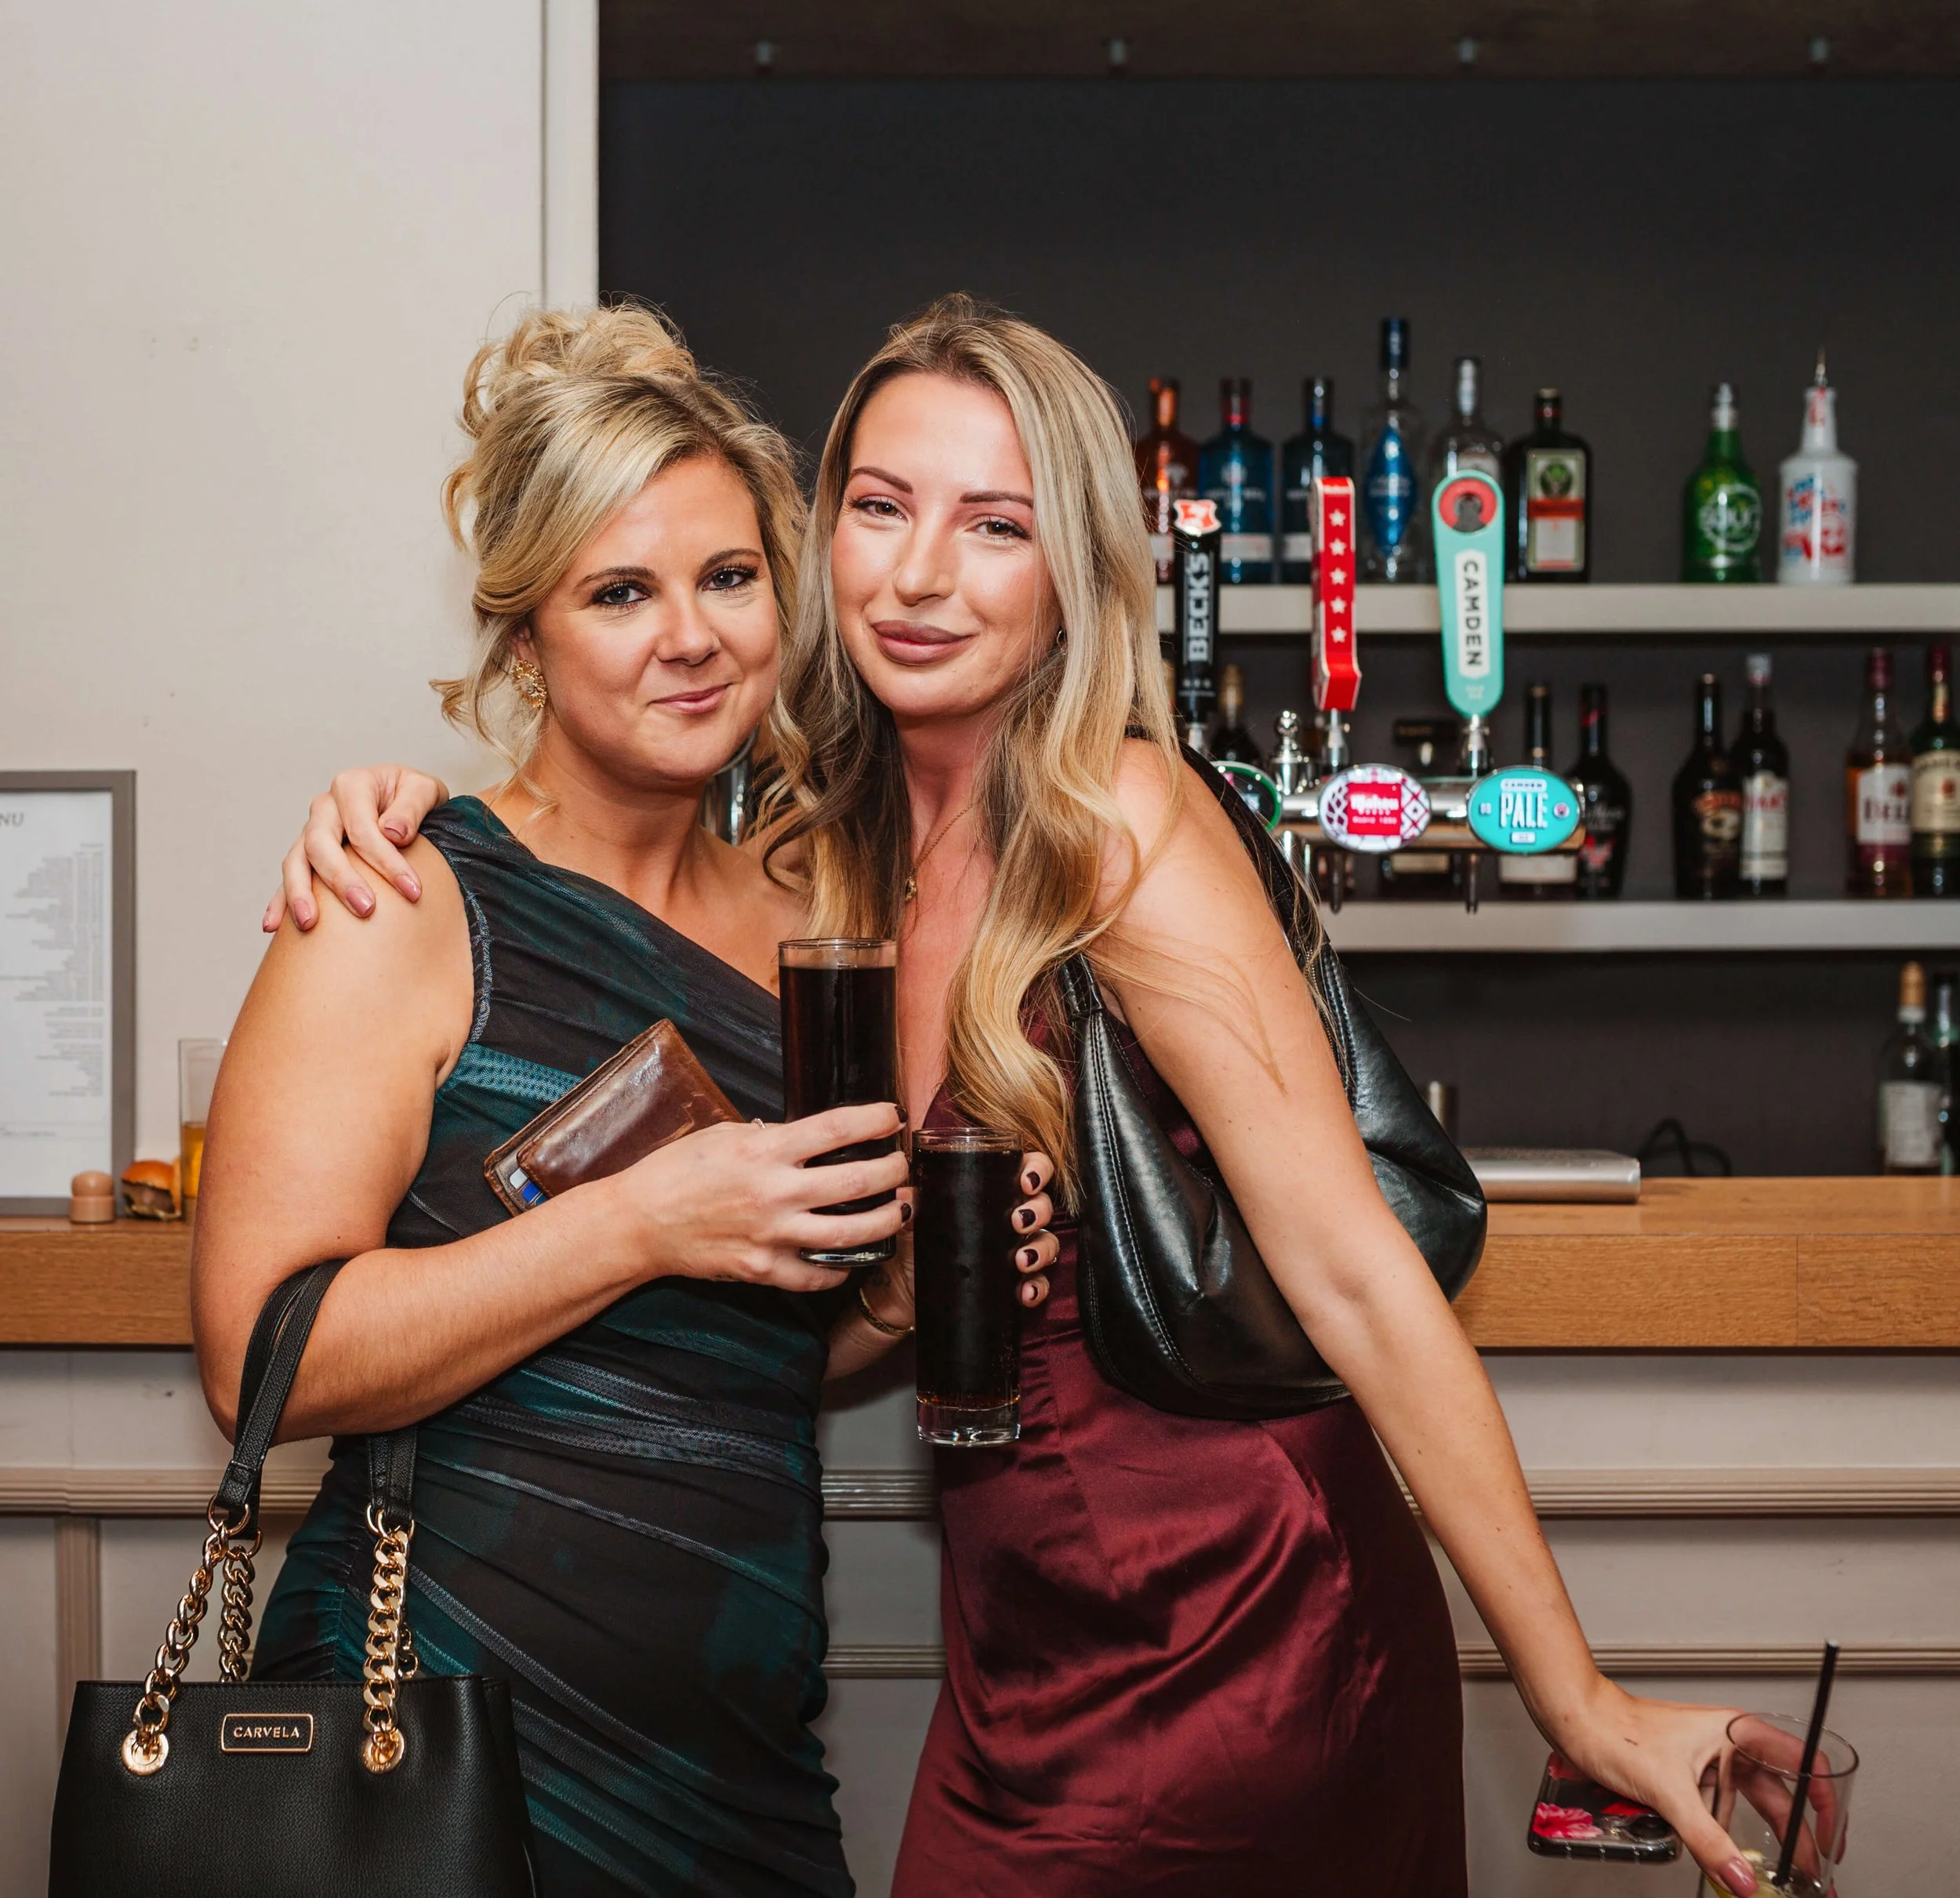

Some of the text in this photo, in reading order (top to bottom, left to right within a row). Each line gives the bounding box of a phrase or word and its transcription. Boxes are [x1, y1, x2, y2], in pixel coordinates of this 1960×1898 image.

[1464, 561, 1483, 666] CAMDEN
[1501, 793, 1548, 828] PALE
[234, 1727, 299, 1738] CARVELA
